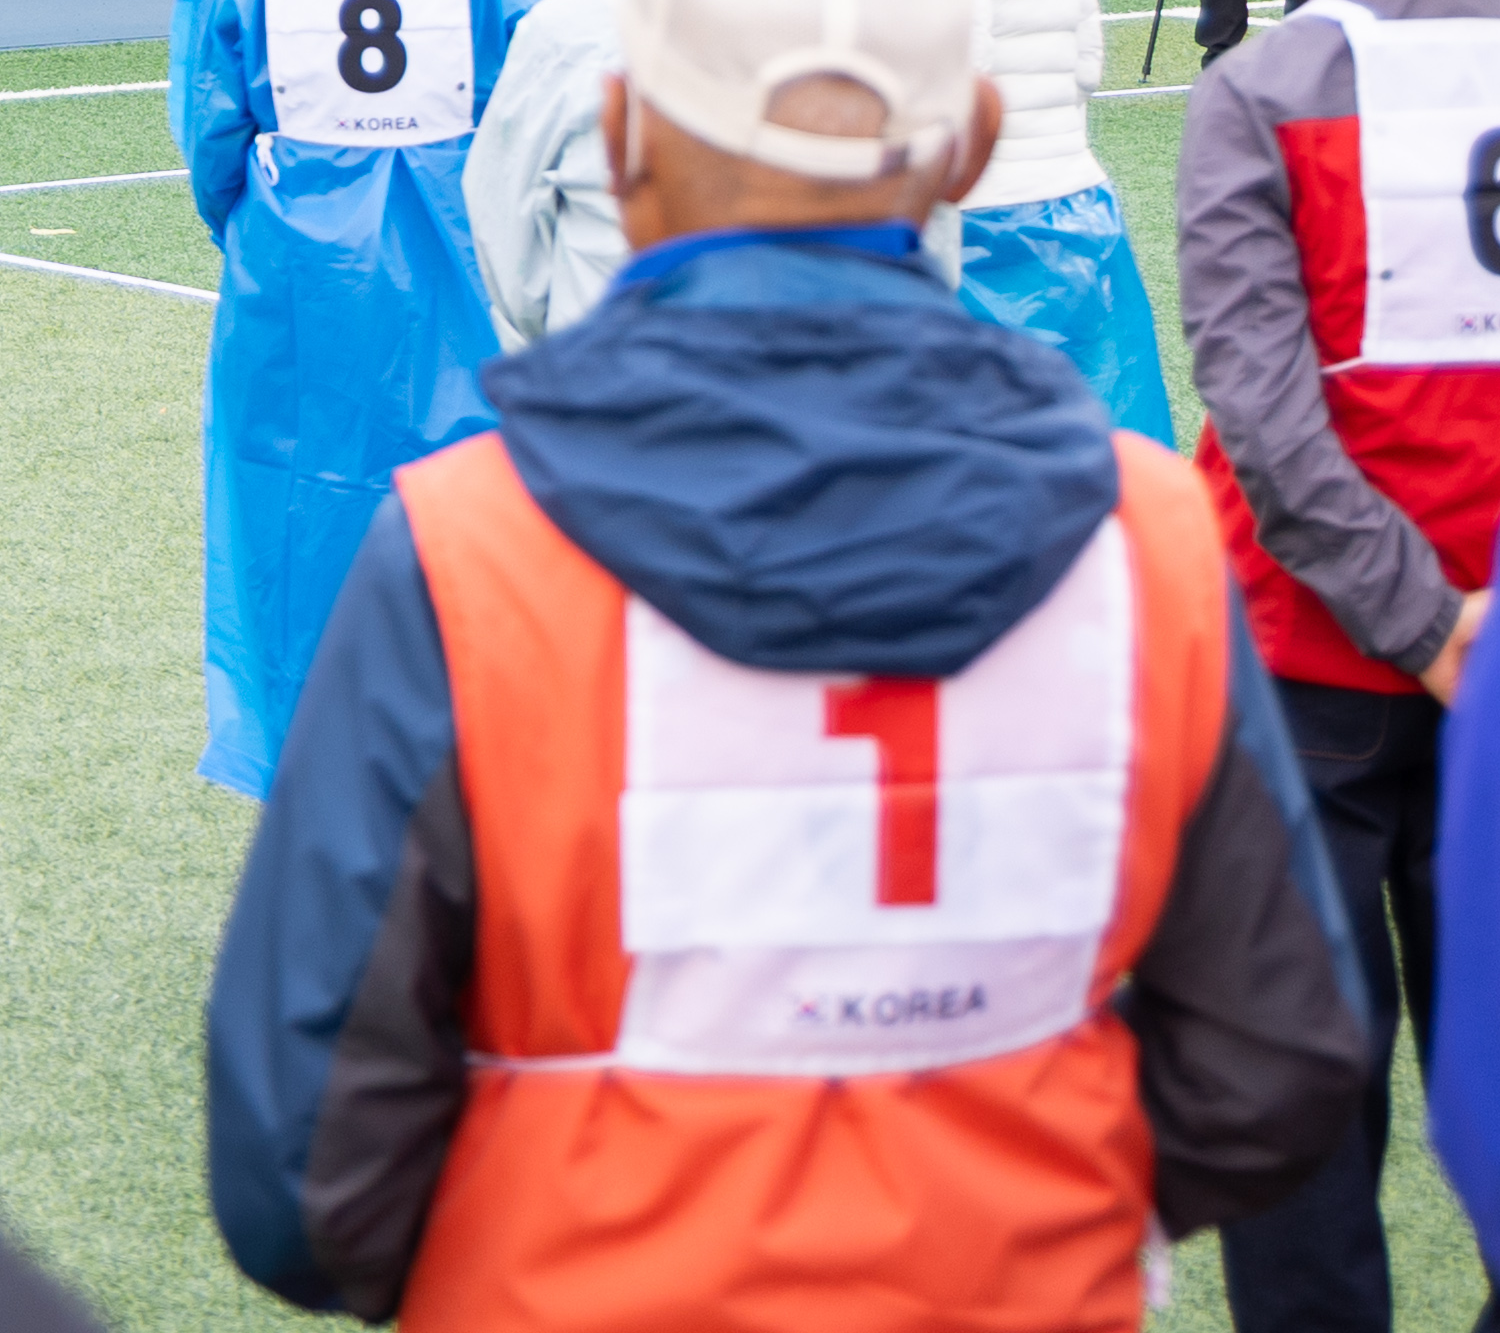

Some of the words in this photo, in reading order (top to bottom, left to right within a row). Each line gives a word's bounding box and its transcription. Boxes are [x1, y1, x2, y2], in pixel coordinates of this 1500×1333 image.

[354, 115, 420, 132] KOREA
[822, 676, 942, 909] 1
[838, 984, 988, 1027] KOREA
